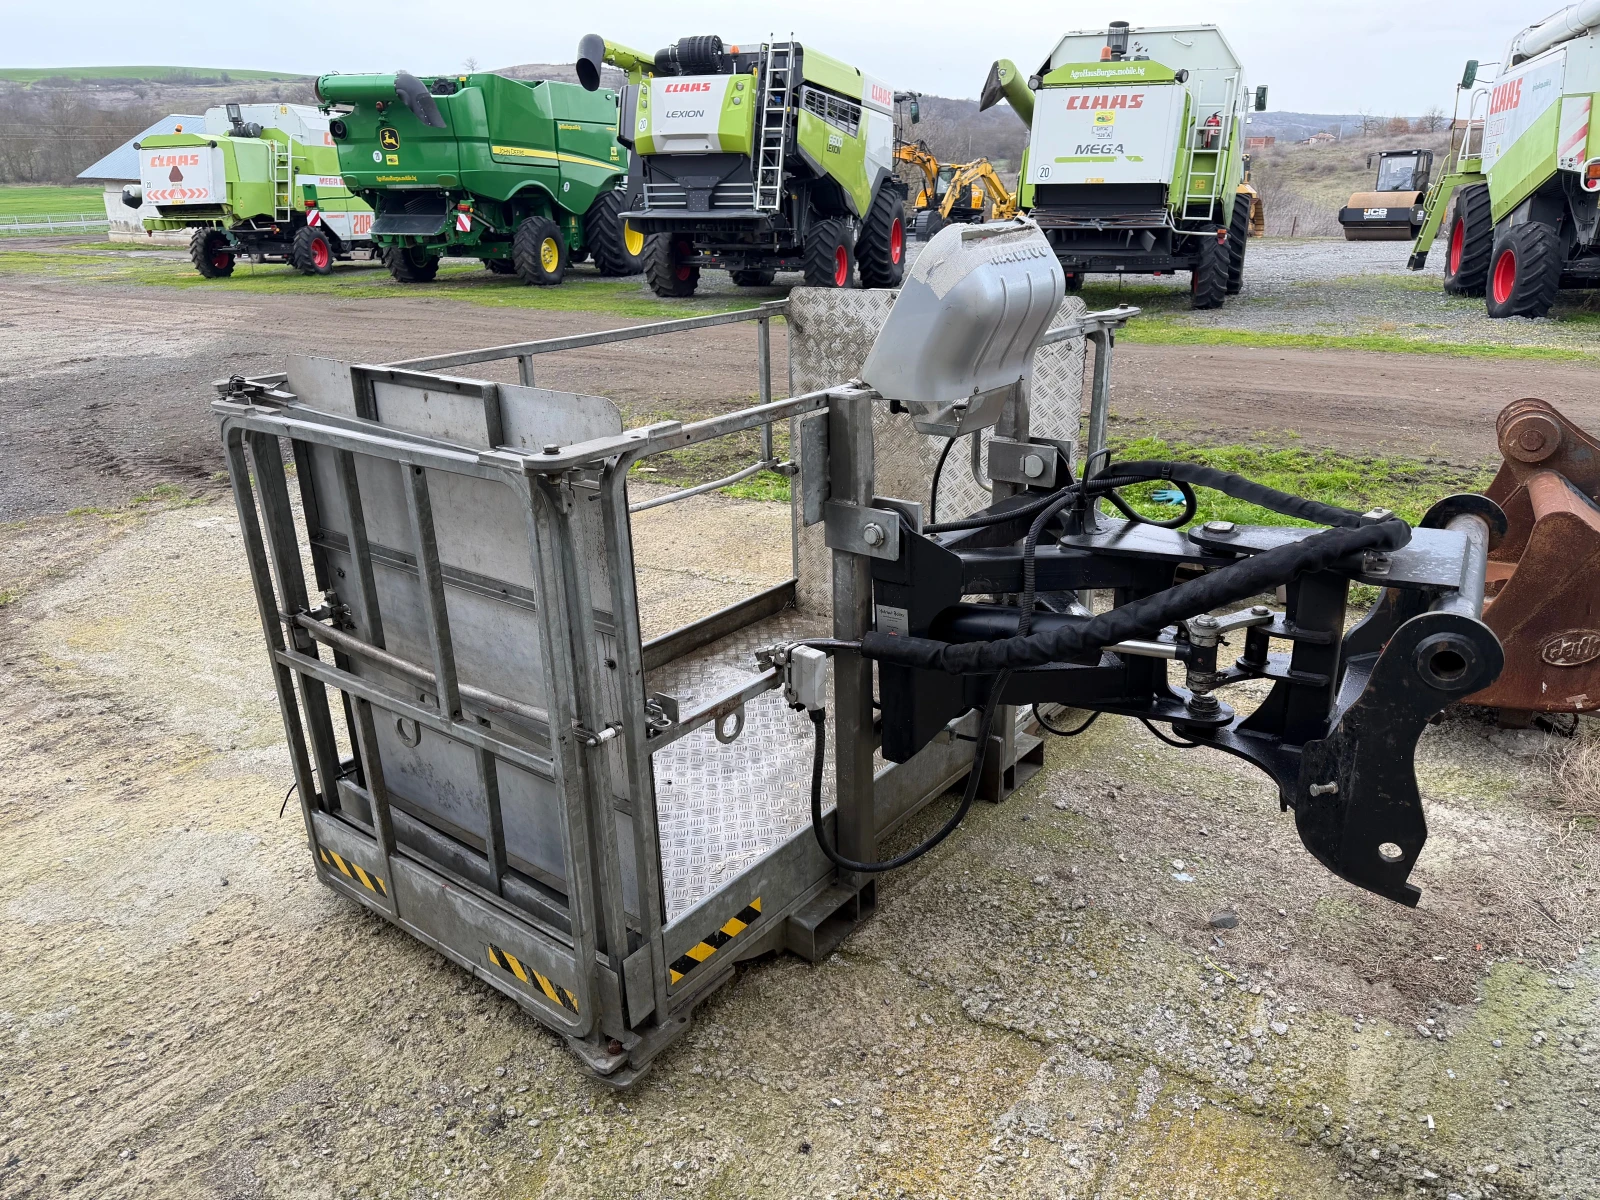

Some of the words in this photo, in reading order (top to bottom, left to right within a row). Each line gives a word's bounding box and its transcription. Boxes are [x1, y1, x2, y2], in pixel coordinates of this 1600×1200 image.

[1070, 67, 1146, 79] AgroHausBurgas.mobile.bg
[665, 83, 711, 93] CLAAS
[871, 84, 891, 106] CLAAS
[1490, 77, 1523, 115] CLAAS
[1066, 94, 1145, 110] CLAAS
[666, 110, 705, 118] LEXION
[826, 143, 841, 154] LEXION
[1075, 143, 1124, 154] MEGA
[150, 154, 199, 167] CLAAS
[1039, 167, 1050, 178] 20
[319, 177, 339, 185] MEGA
[1363, 208, 1388, 216] JCB
